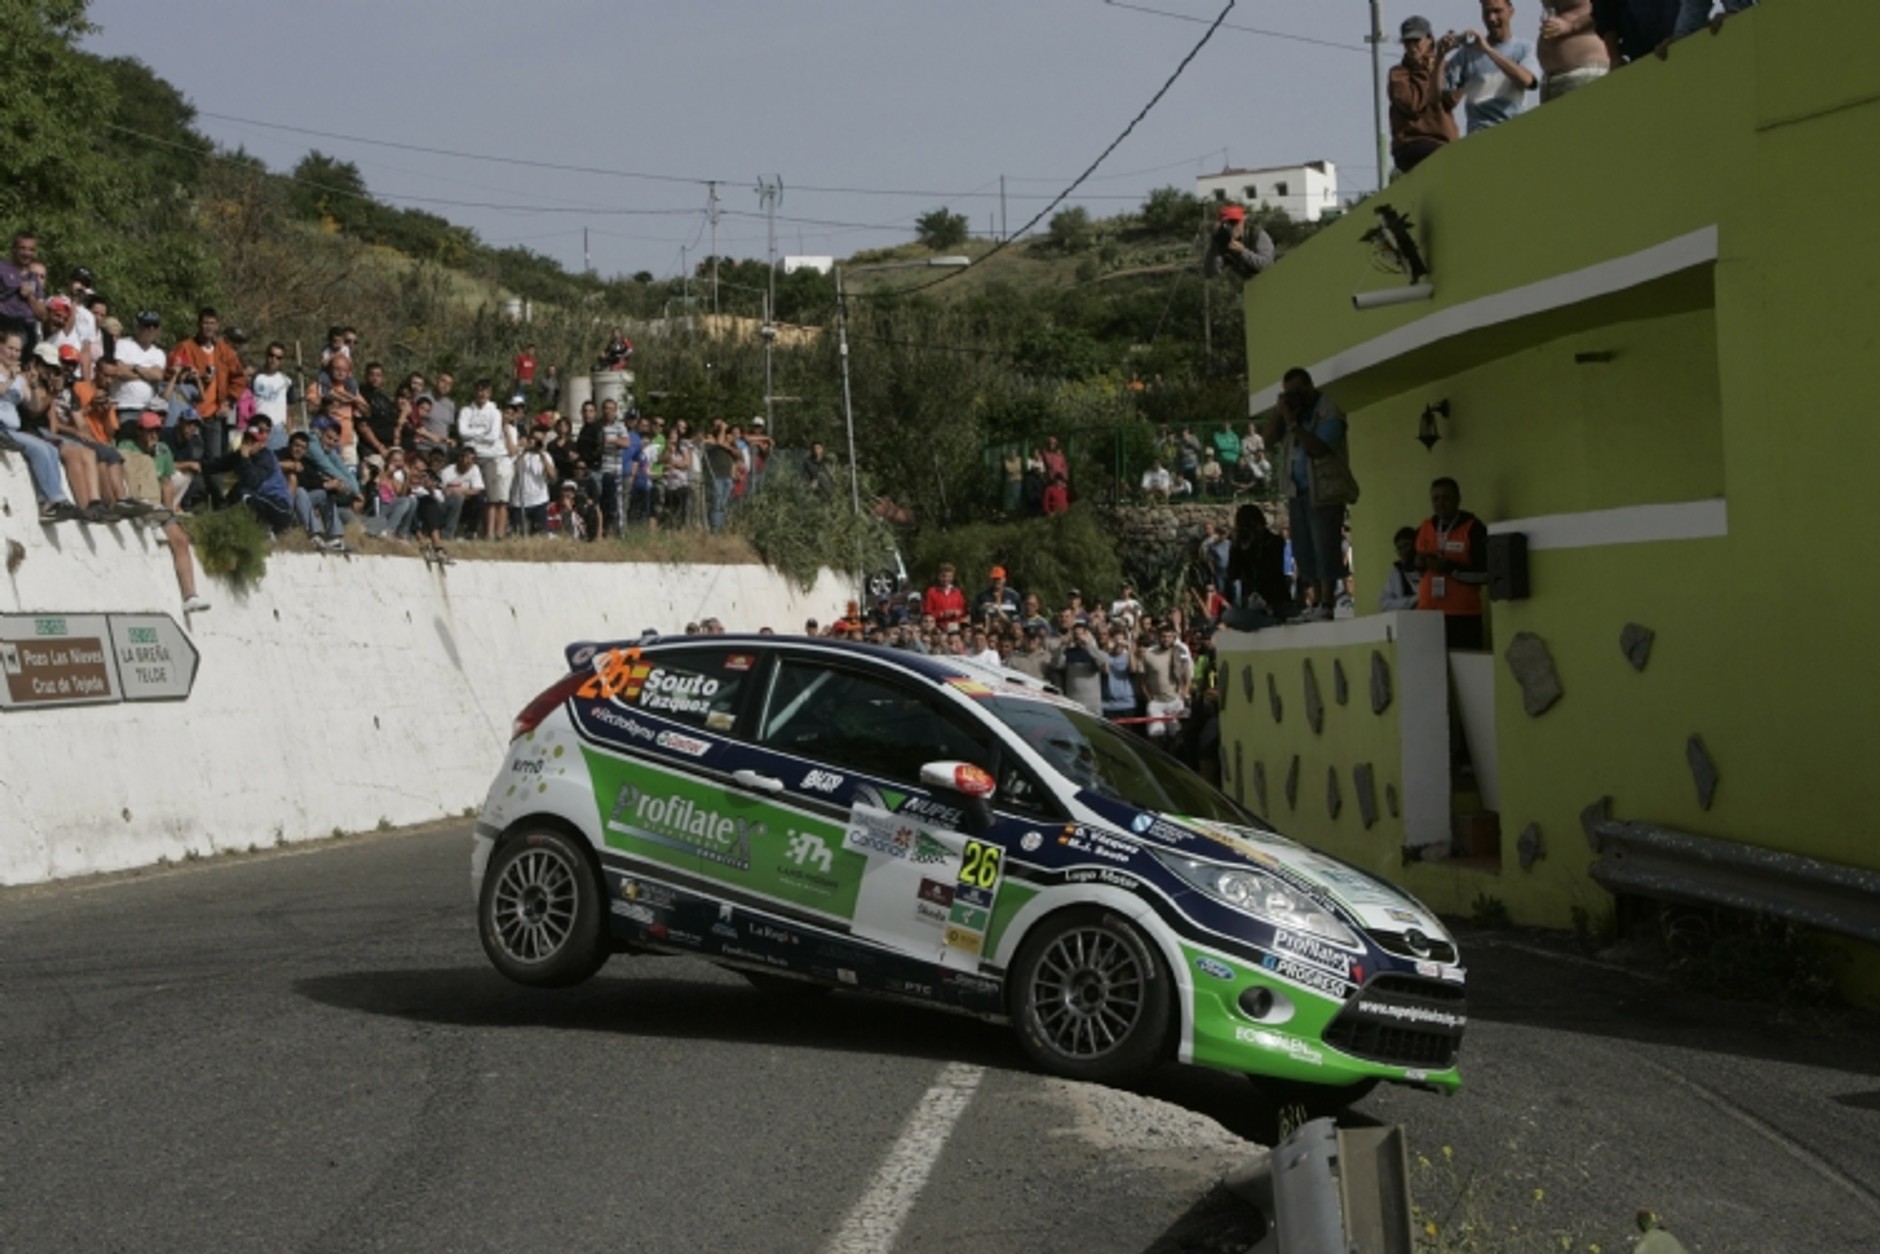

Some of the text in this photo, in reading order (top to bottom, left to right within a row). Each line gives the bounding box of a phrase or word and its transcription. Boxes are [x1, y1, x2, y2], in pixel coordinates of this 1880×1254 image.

[58, 678, 71, 692] de
[576, 646, 642, 698] 26
[644, 669, 719, 695] Souto
[959, 842, 1001, 888] 26
[1276, 960, 1346, 997] PROGRESO
